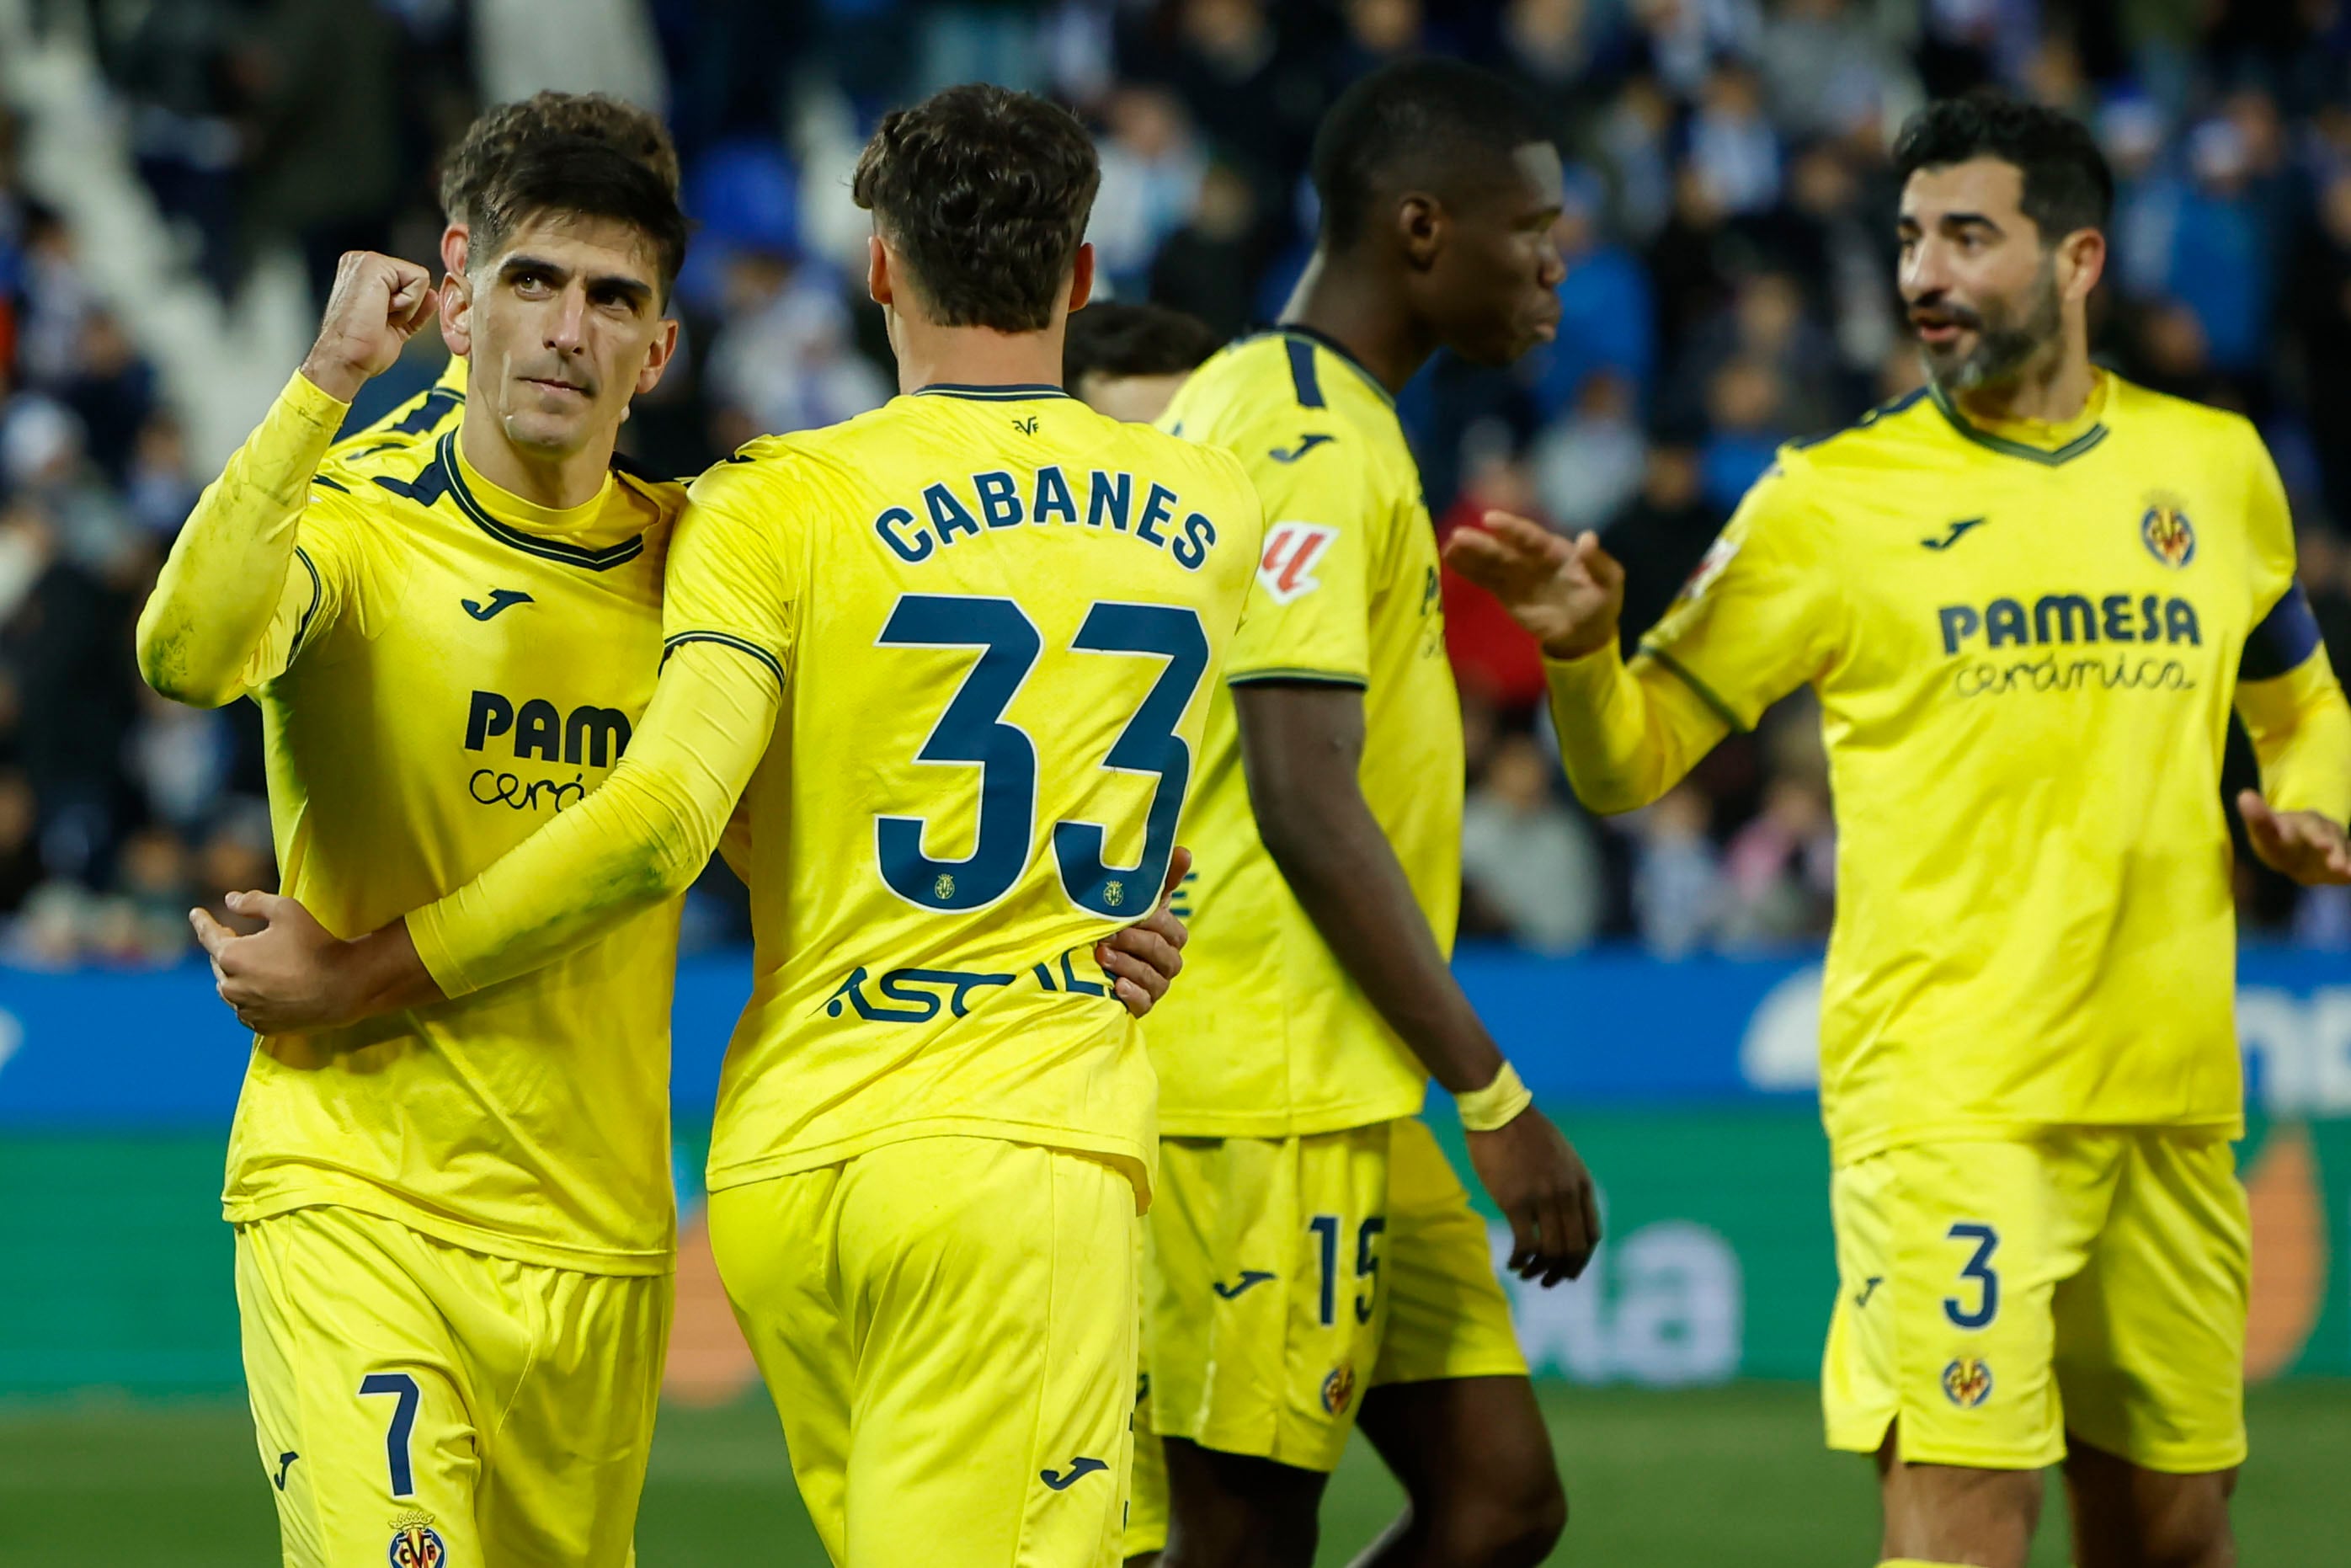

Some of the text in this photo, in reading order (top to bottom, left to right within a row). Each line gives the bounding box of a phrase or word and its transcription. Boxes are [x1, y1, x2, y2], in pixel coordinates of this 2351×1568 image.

[873, 464, 1218, 573] CABANES
[1938, 594, 2202, 655] PAMESA
[1956, 653, 2196, 698] cerámica
[873, 593, 1211, 920] 33
[1309, 1214, 1386, 1328] 15
[1943, 1223, 2001, 1331] 3
[359, 1373, 421, 1497] 7
